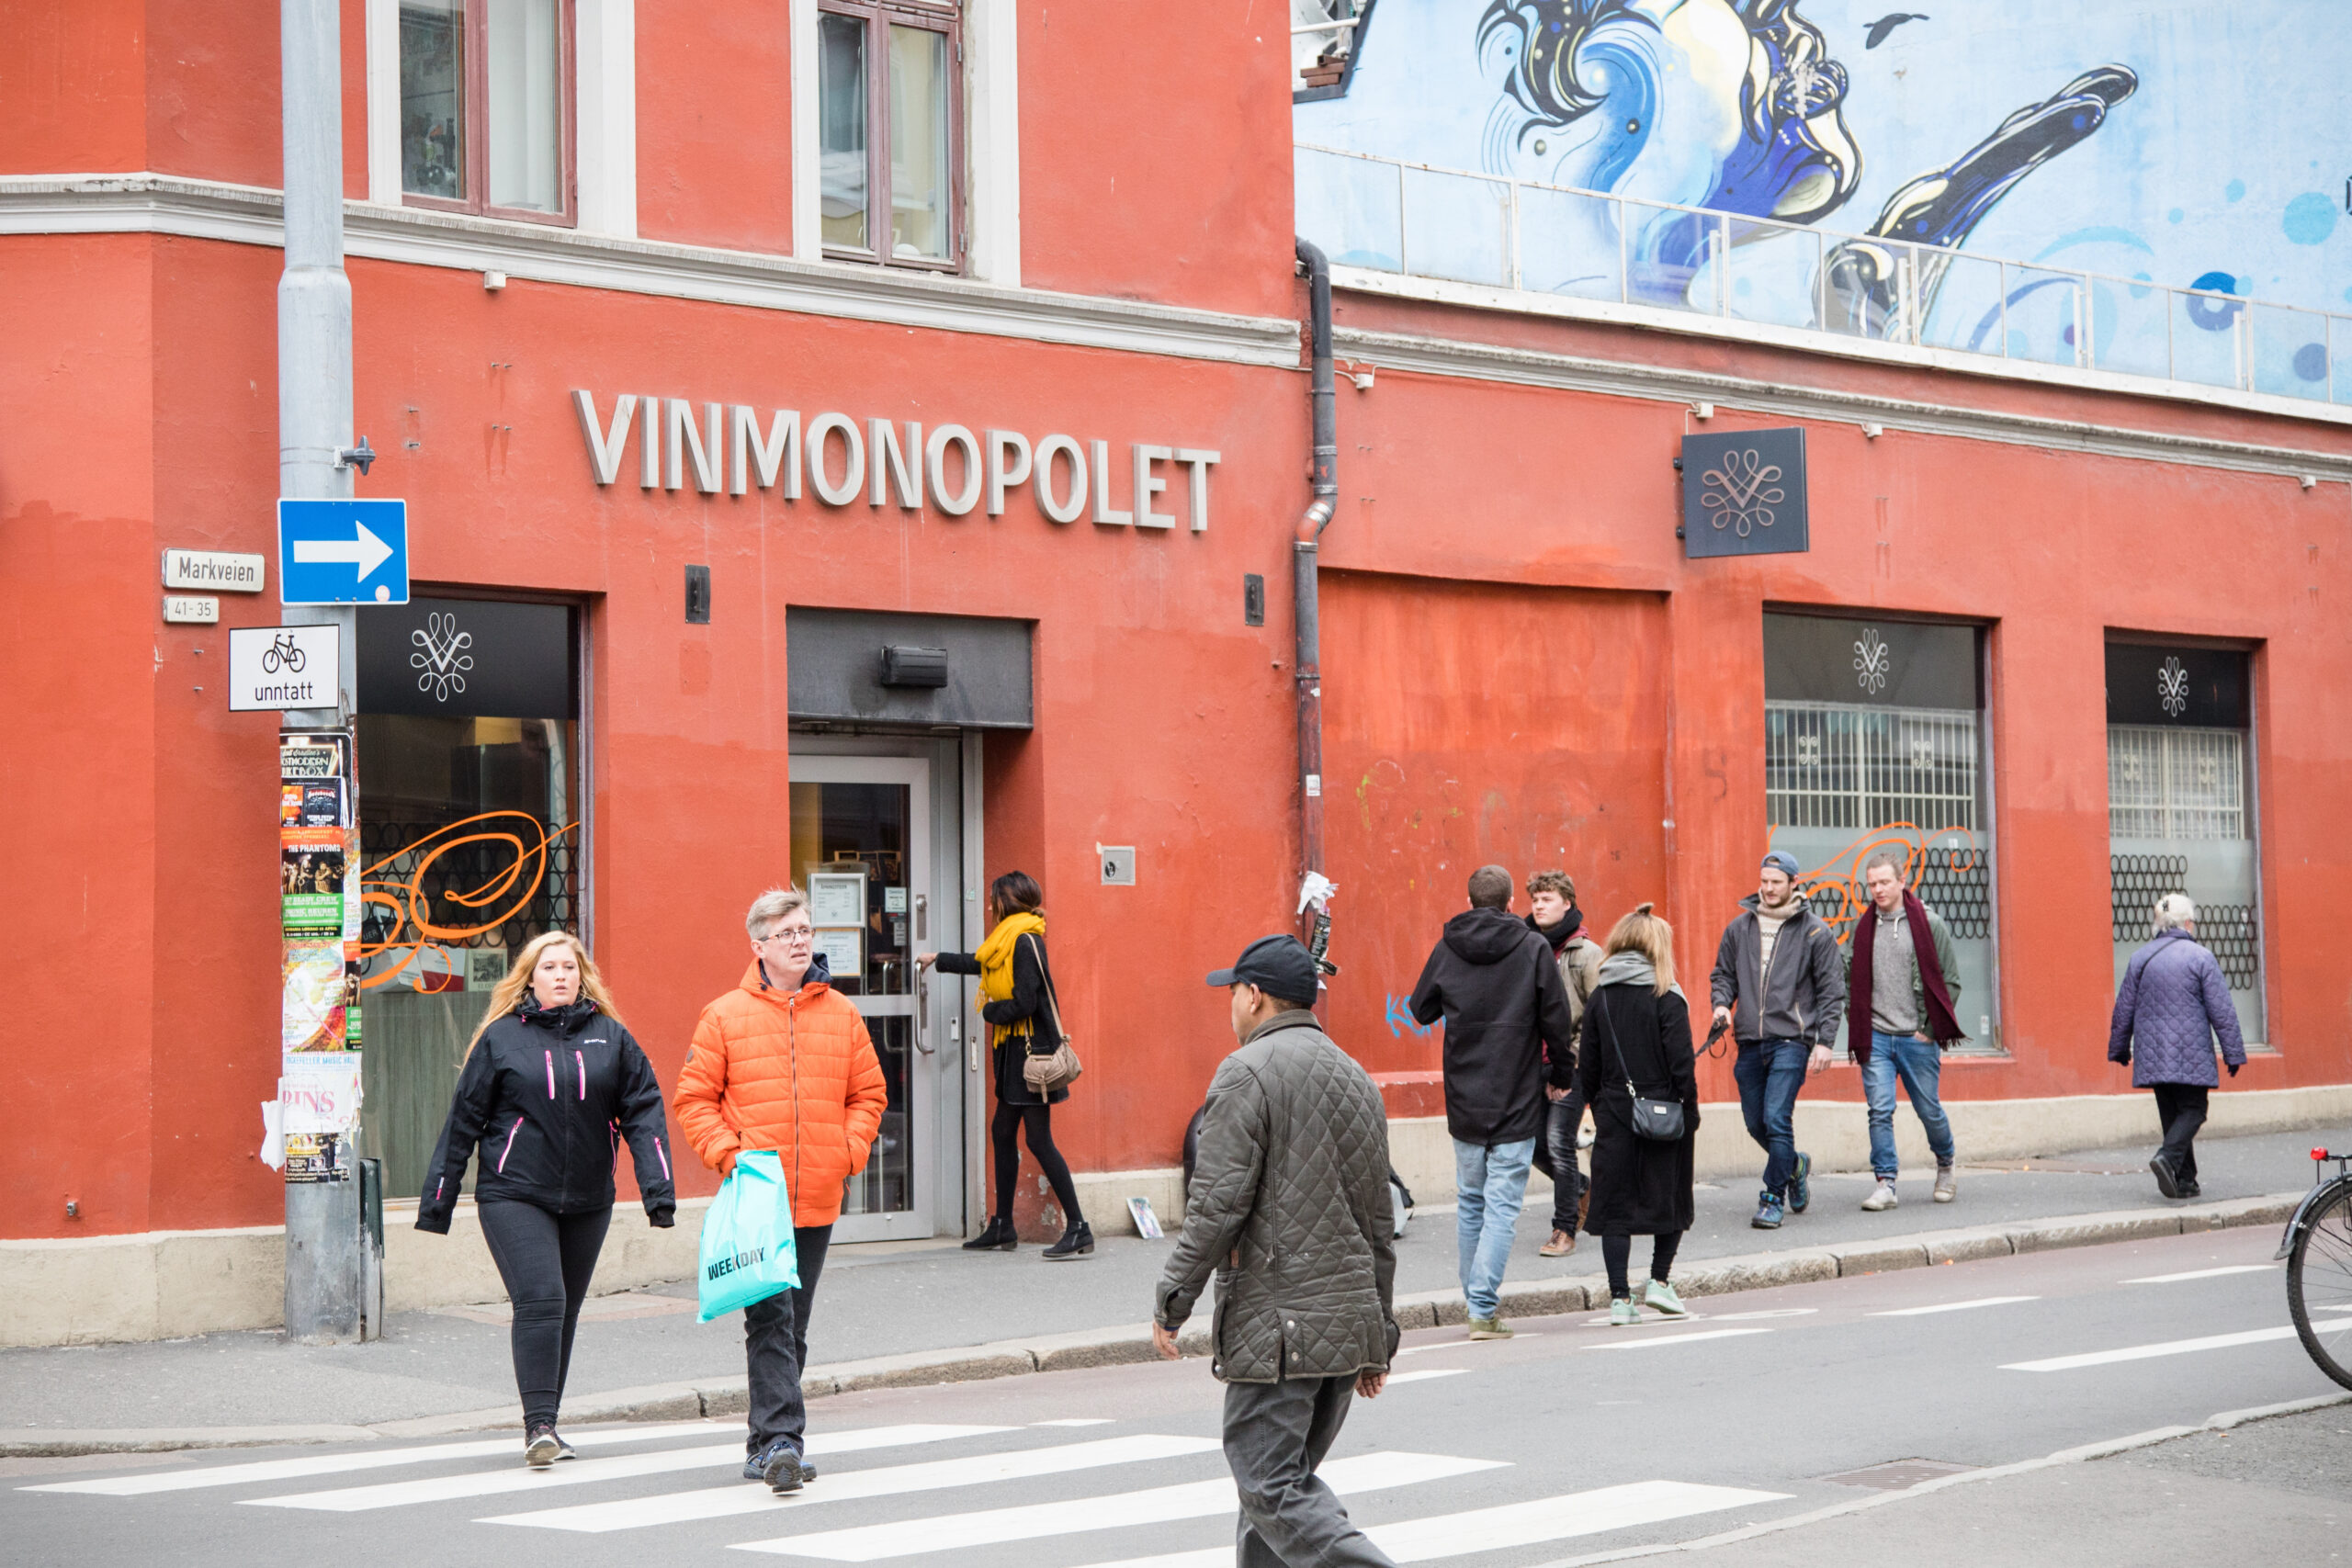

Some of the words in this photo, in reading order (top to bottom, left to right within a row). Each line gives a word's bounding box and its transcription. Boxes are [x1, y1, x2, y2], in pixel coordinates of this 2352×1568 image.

[571, 389, 1222, 533] VINMONOPOLET
[179, 556, 254, 583] Markveien
[254, 681, 313, 702] unntatt
[288, 844, 300, 852] THE
[300, 843, 341, 852] PHANTOMS
[363, 928, 379, 941] UER
[322, 1055, 342, 1065] MUSIC
[707, 1247, 765, 1281] WEEKDAY
